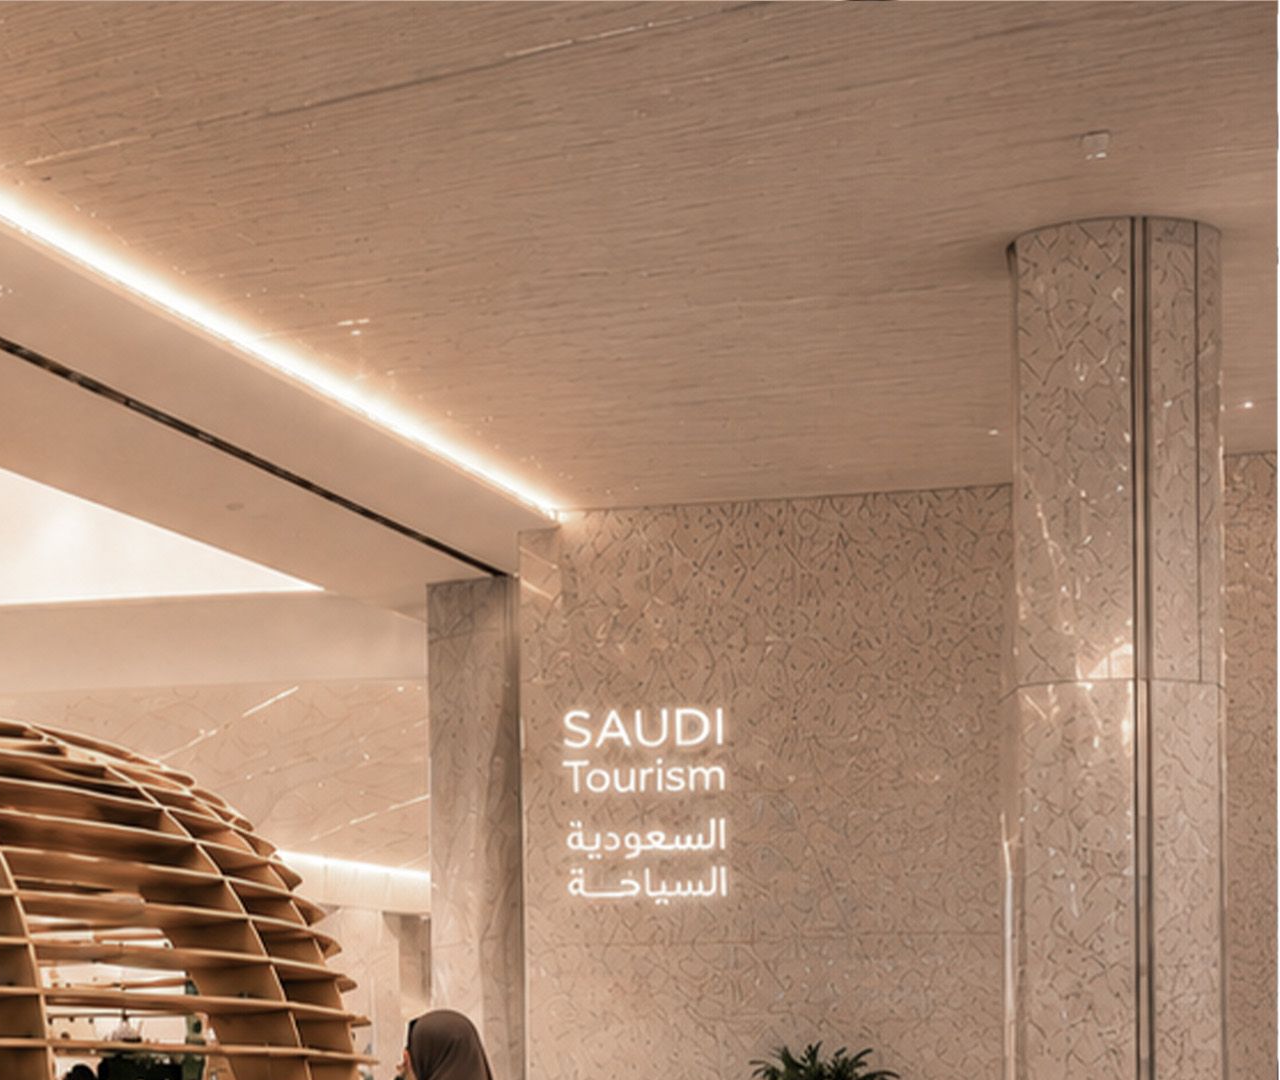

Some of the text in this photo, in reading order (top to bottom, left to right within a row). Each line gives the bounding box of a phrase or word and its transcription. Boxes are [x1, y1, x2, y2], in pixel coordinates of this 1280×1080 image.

[563, 707, 724, 748] SAUDI
[562, 758, 726, 793] Tourism
[566, 818, 726, 860] السعودية
